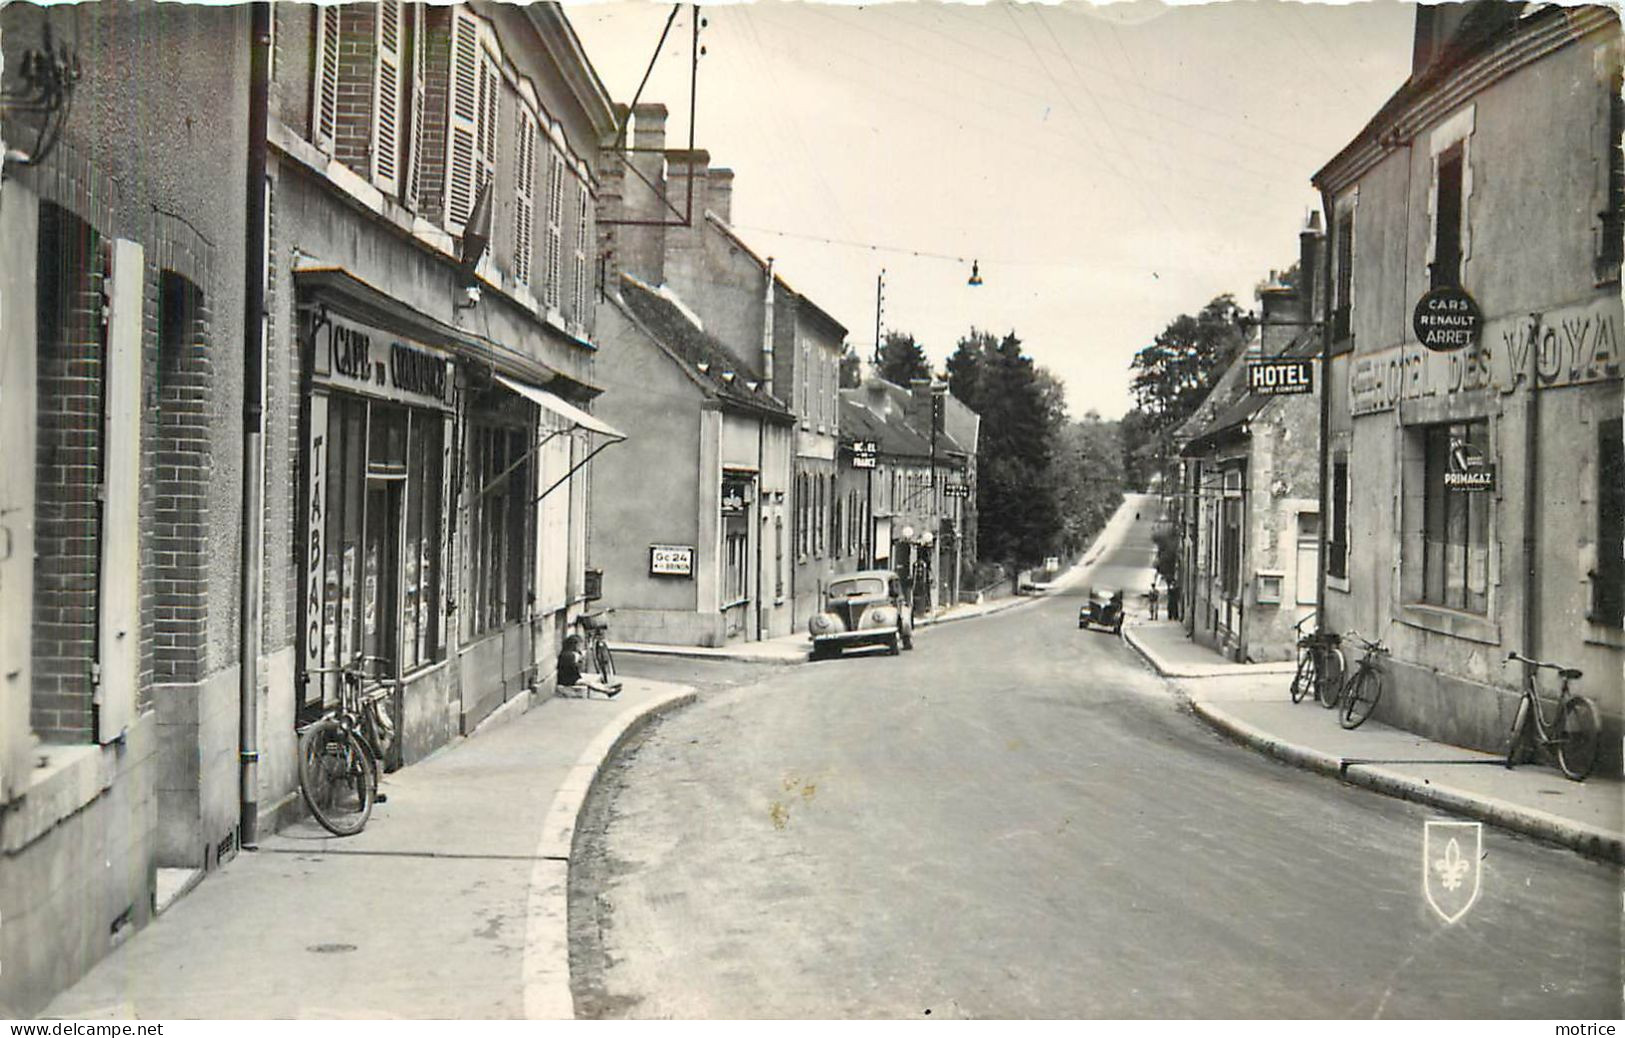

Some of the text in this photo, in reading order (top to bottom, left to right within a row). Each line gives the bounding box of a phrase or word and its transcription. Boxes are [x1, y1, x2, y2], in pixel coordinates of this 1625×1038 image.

[1429, 299, 1468, 310] CARS
[1421, 315, 1474, 326] RENAULT
[1426, 330, 1472, 344] ARRET
[1253, 364, 1310, 387] HOTEL
[1444, 472, 1492, 485] PRIMAGAZ
[308, 435, 323, 660] TABAC
